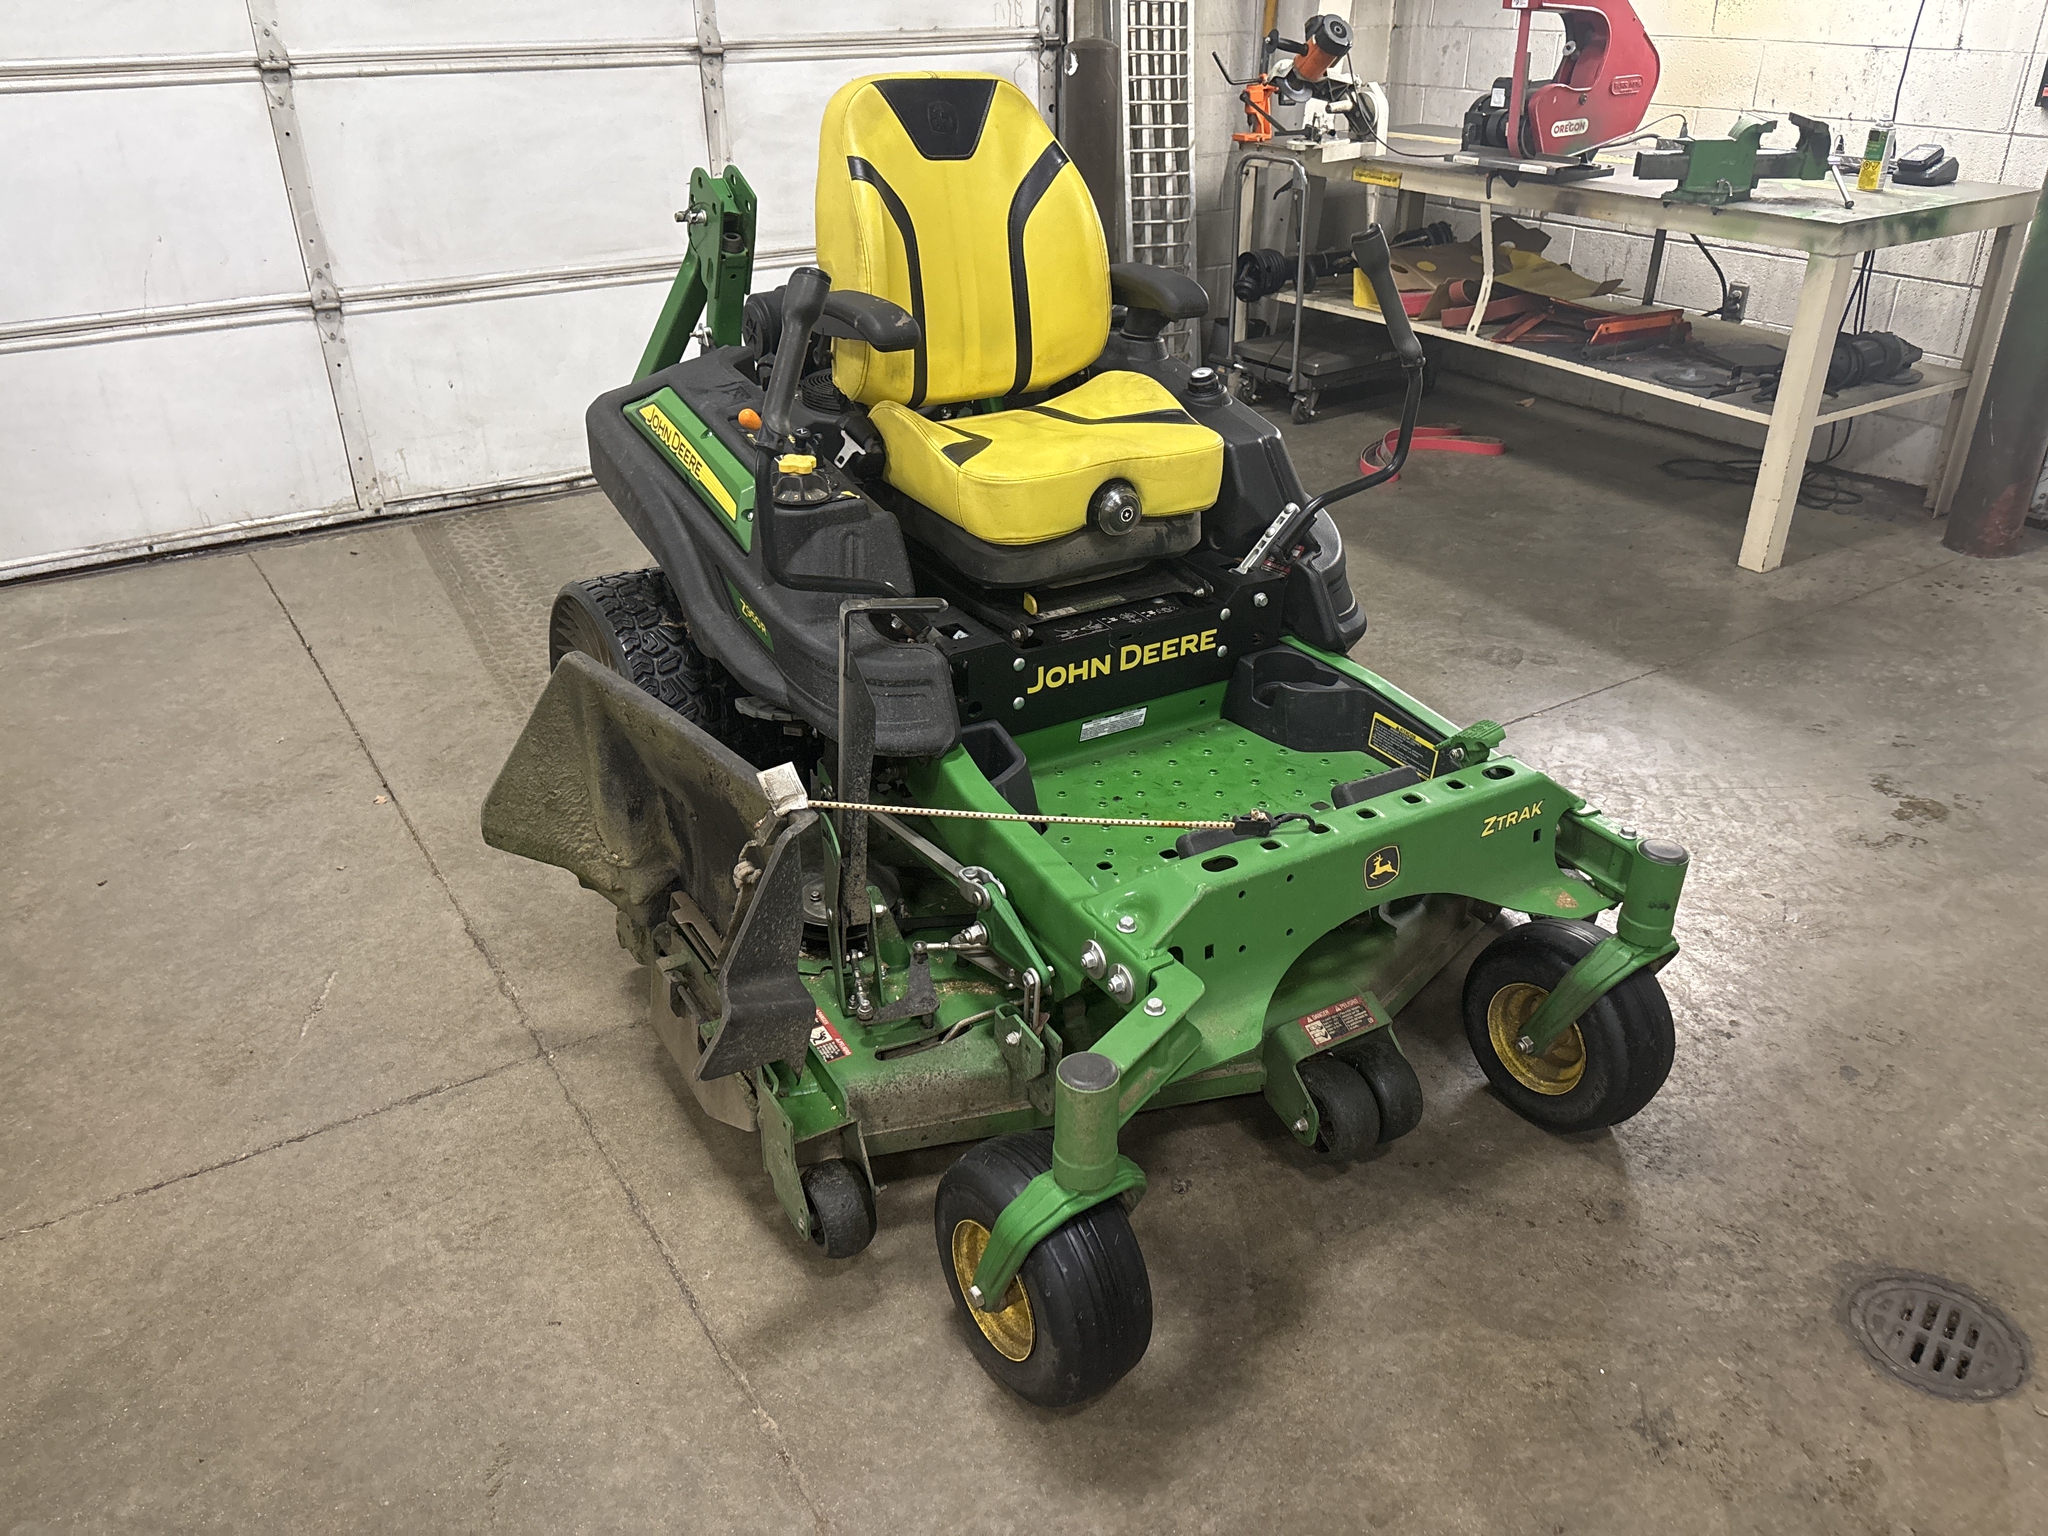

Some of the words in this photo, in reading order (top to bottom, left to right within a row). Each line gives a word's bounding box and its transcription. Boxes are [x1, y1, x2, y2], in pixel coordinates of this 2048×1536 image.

[1553, 121, 1586, 134] OREGON
[646, 407, 672, 444] JOHN
[671, 431, 703, 479] DEERE
[1026, 653, 1112, 695] JOHN
[1119, 628, 1218, 671] DEERE
